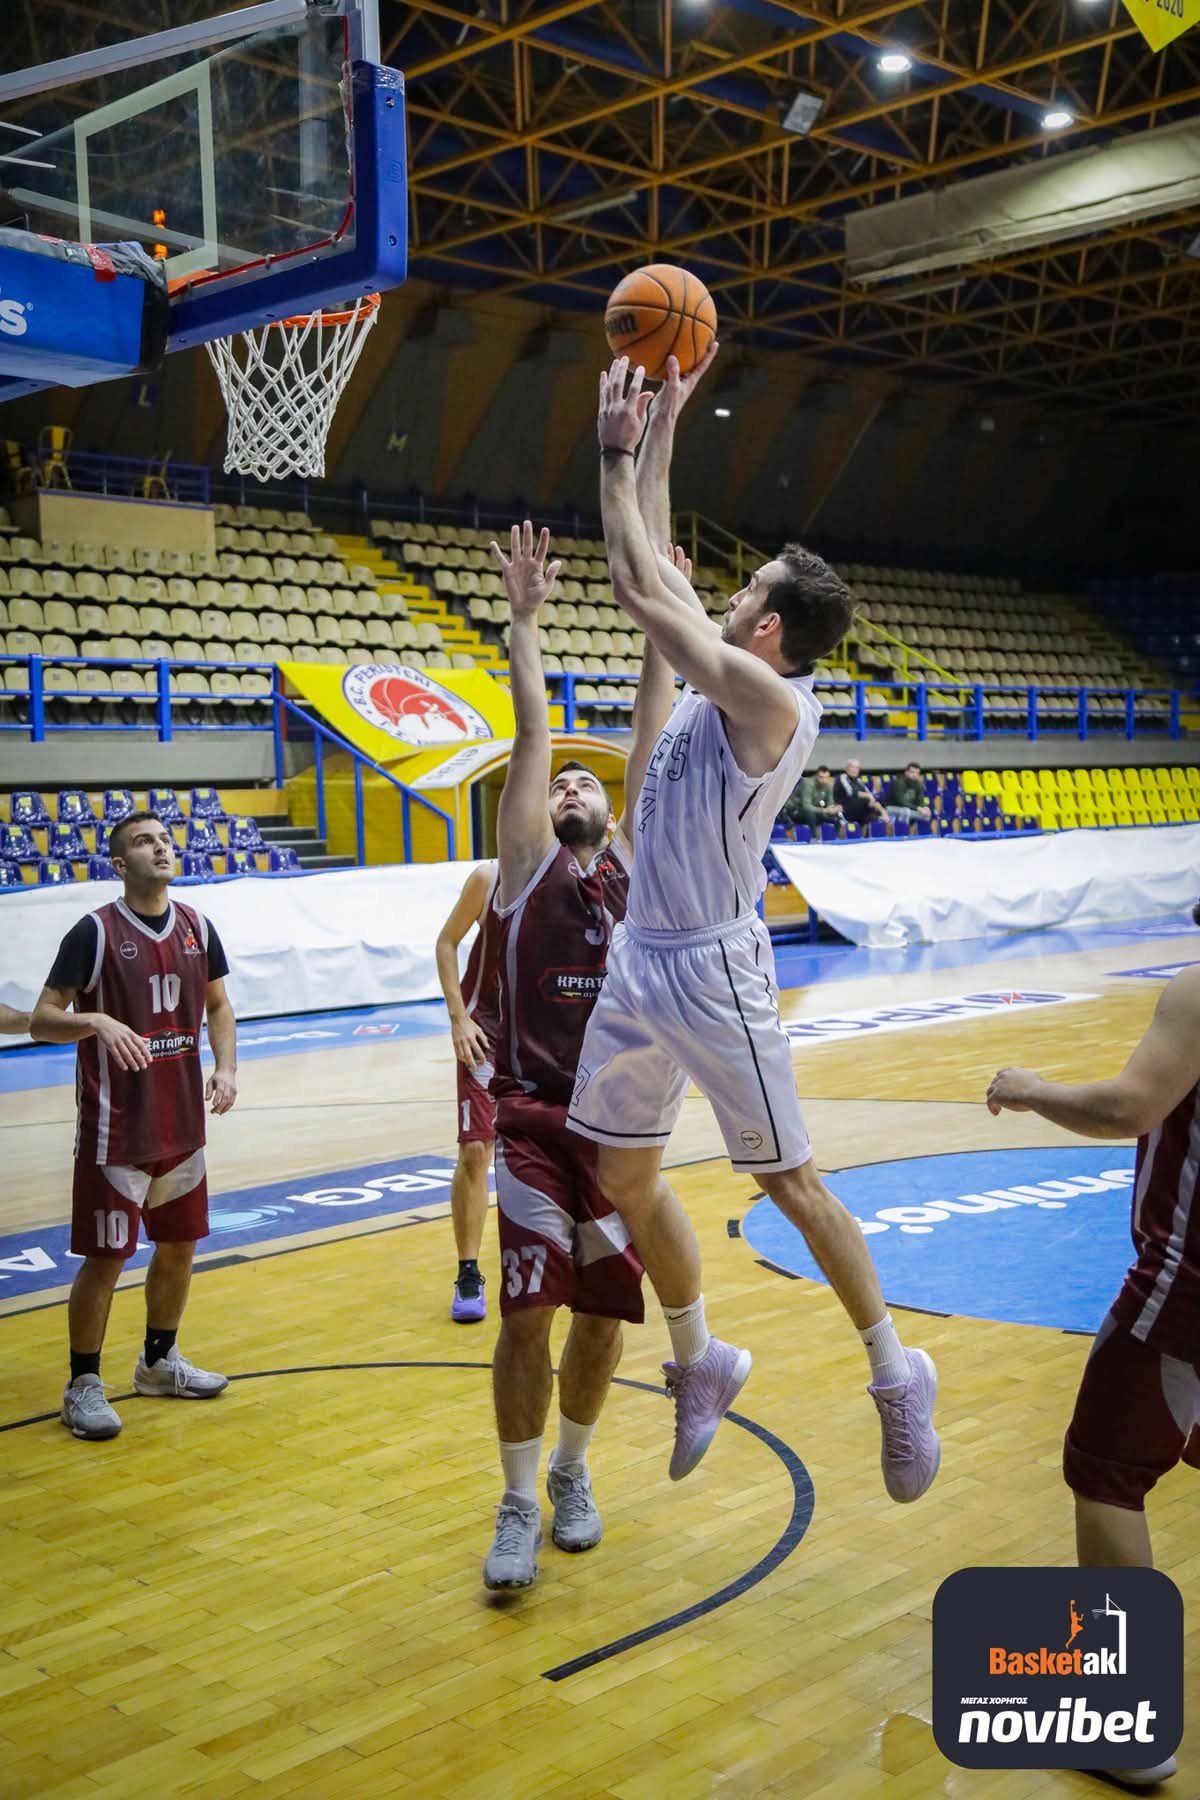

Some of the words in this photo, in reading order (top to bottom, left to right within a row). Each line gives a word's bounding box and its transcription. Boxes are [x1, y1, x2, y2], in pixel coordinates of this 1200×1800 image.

[148, 973, 182, 1014] 10
[557, 975, 603, 990] ΚΡΕΑΤ
[94, 1209, 129, 1249] 10
[502, 1244, 547, 1298] 37
